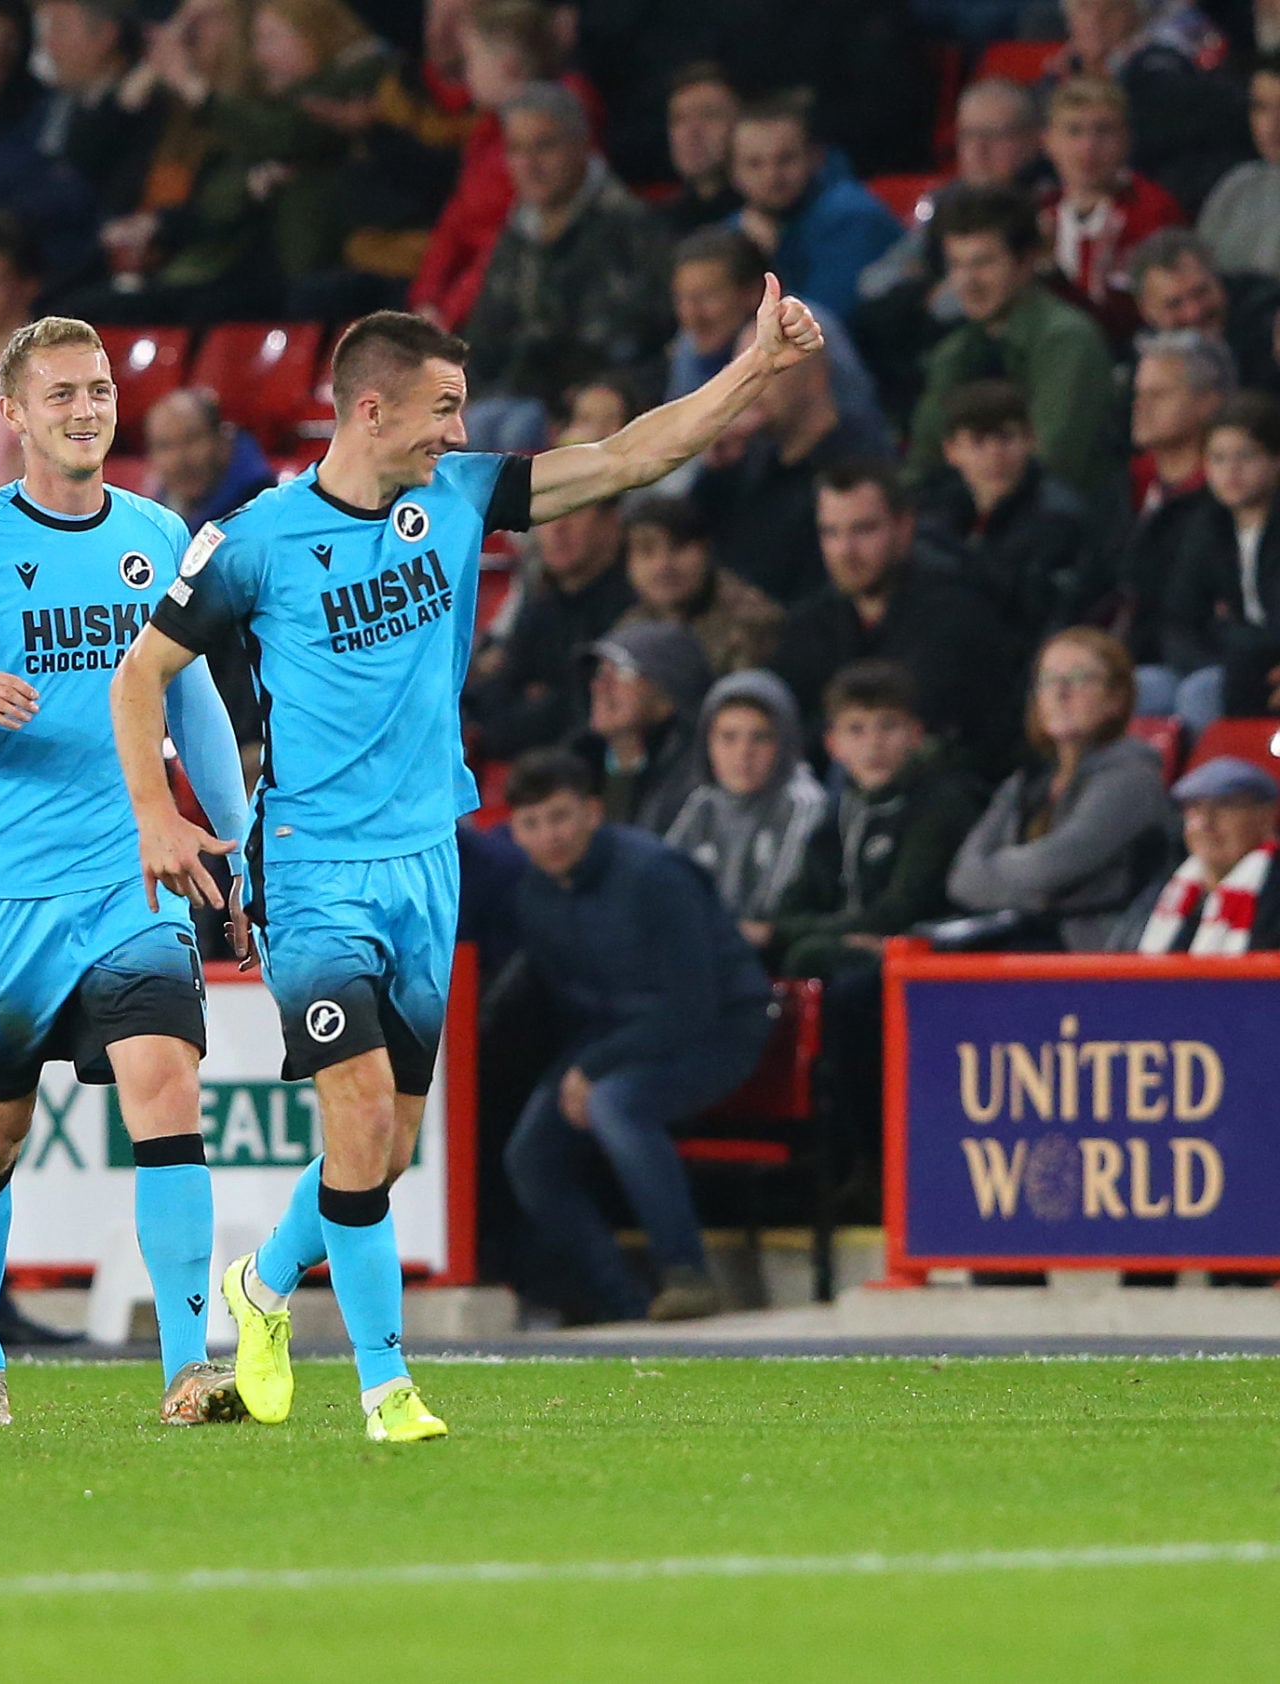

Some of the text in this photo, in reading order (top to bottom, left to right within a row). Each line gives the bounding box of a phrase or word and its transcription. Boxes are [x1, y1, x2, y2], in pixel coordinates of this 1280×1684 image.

[320, 549, 449, 634] HUSKI
[330, 591, 453, 654] CHOCOLATE
[26, 648, 125, 675] CHOCOLA
[201, 1086, 324, 1162] EALT
